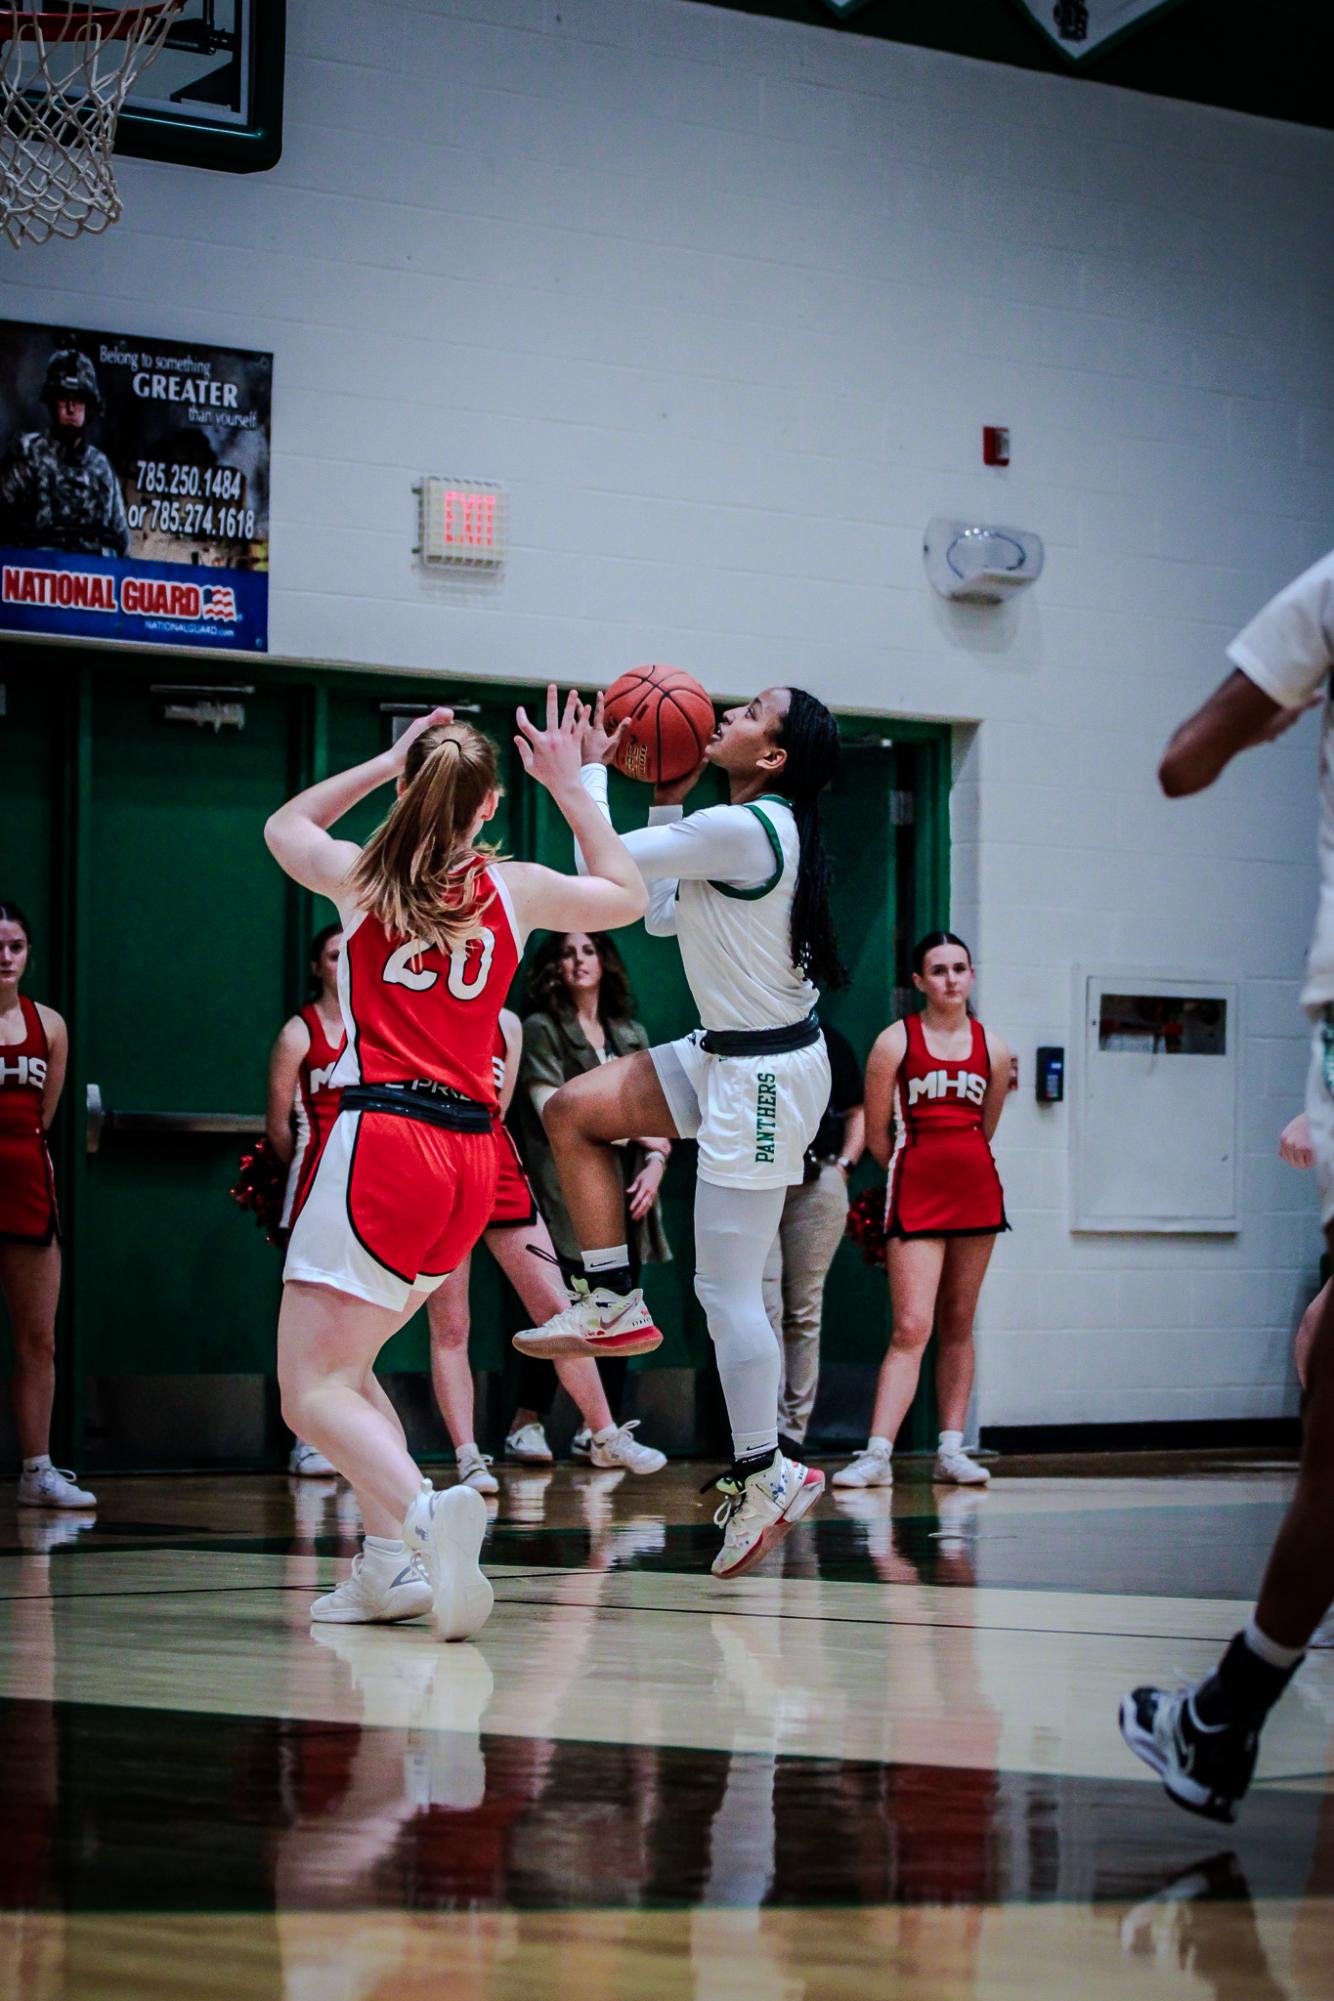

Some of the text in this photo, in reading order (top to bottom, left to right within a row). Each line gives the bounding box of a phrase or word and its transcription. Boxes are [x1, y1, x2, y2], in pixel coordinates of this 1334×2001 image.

[100, 345, 212, 379] Belong to something
[132, 372, 239, 408] GREATER
[188, 405, 257, 429] than yourself
[136, 460, 242, 500] 785.250.1484
[128, 499, 256, 540] or 785.274.1618
[444, 491, 497, 545] EXIT
[2, 565, 202, 620] NATIONAL GUARD
[382, 926, 497, 1001] 20
[908, 1069, 988, 1106] MHS
[755, 1072, 777, 1164] PANTHERS
